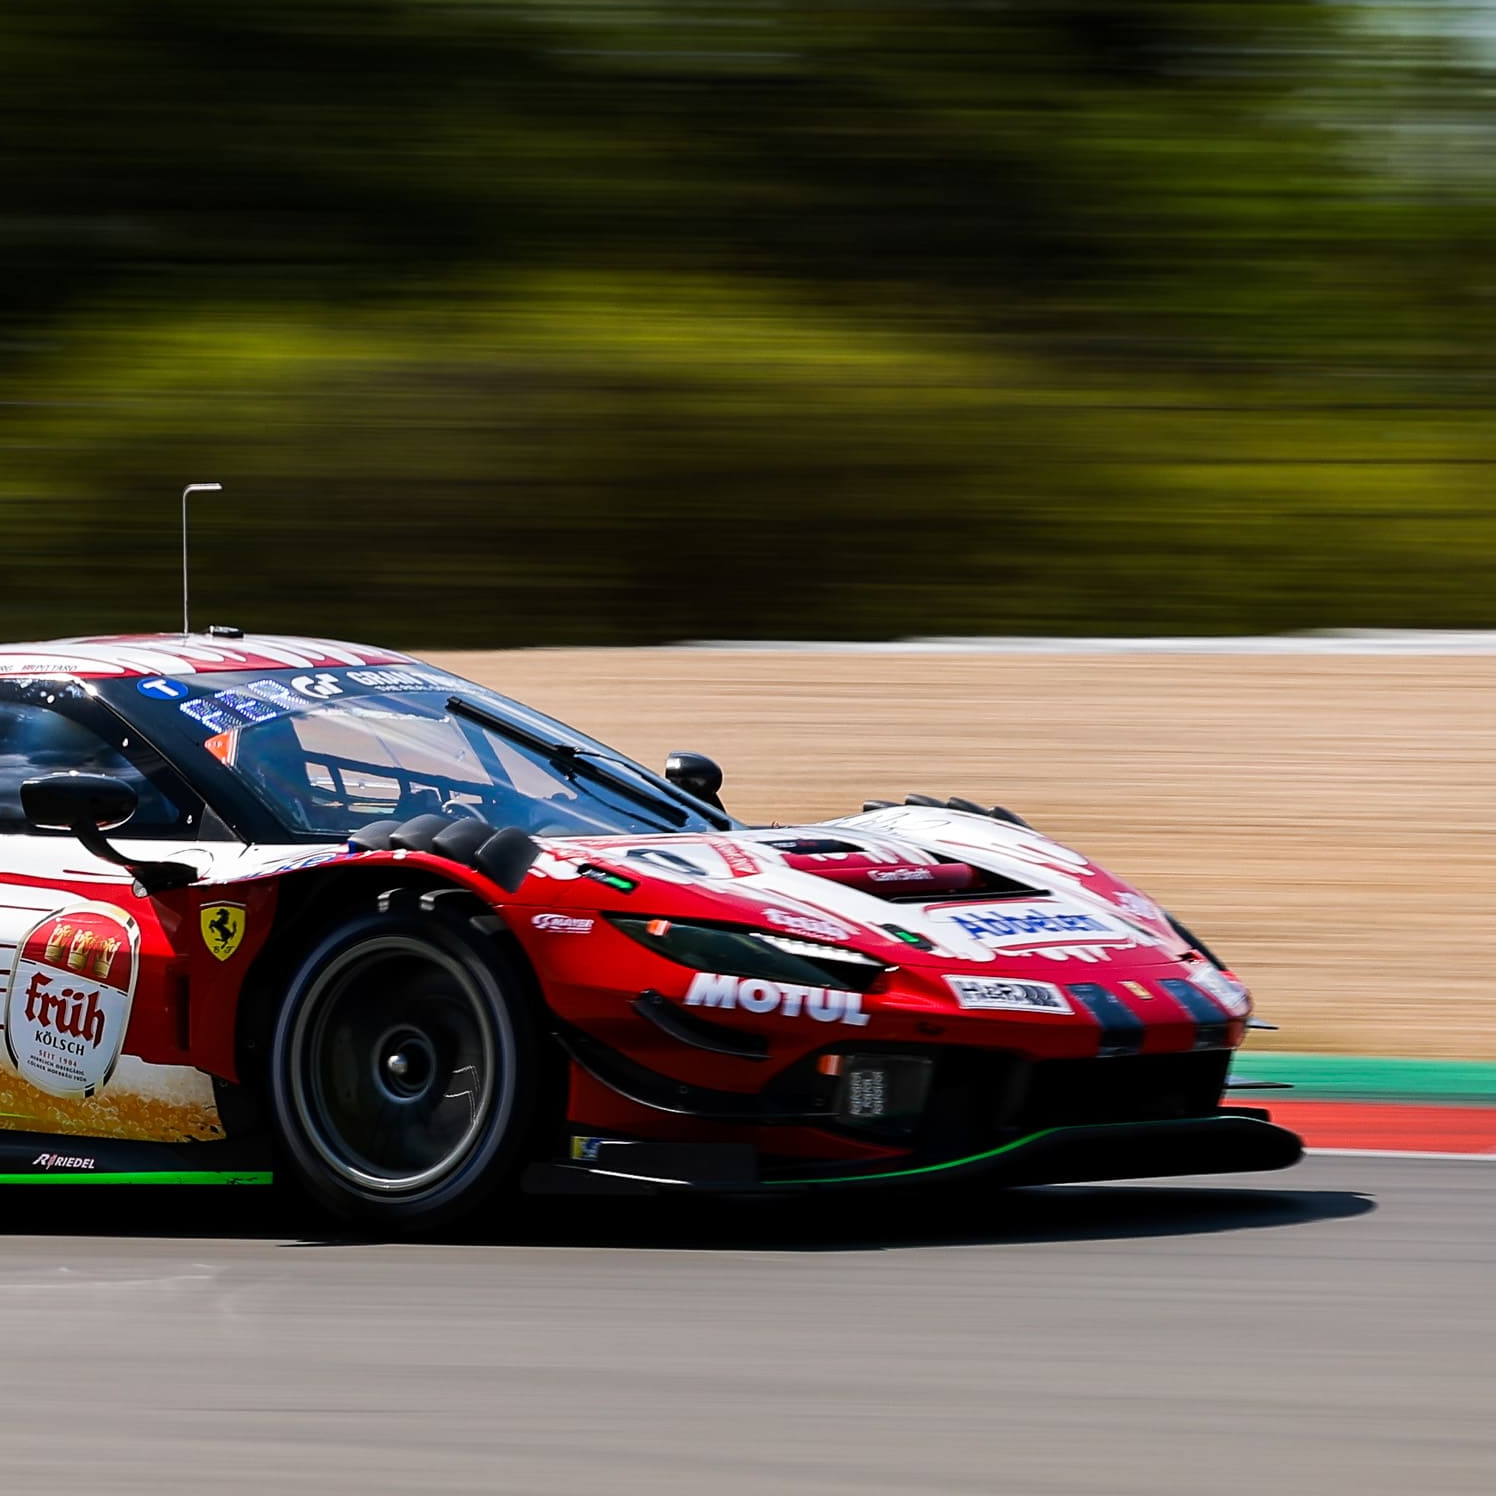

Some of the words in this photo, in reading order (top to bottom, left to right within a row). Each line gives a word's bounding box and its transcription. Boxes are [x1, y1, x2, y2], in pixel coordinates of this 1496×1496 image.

[25, 972, 106, 1049] früh
[685, 972, 871, 1026] MOTUL
[35, 1030, 85, 1056] KÖLSCH
[39, 1050, 55, 1060] SEIT
[54, 1156, 95, 1169] RIEDEL
